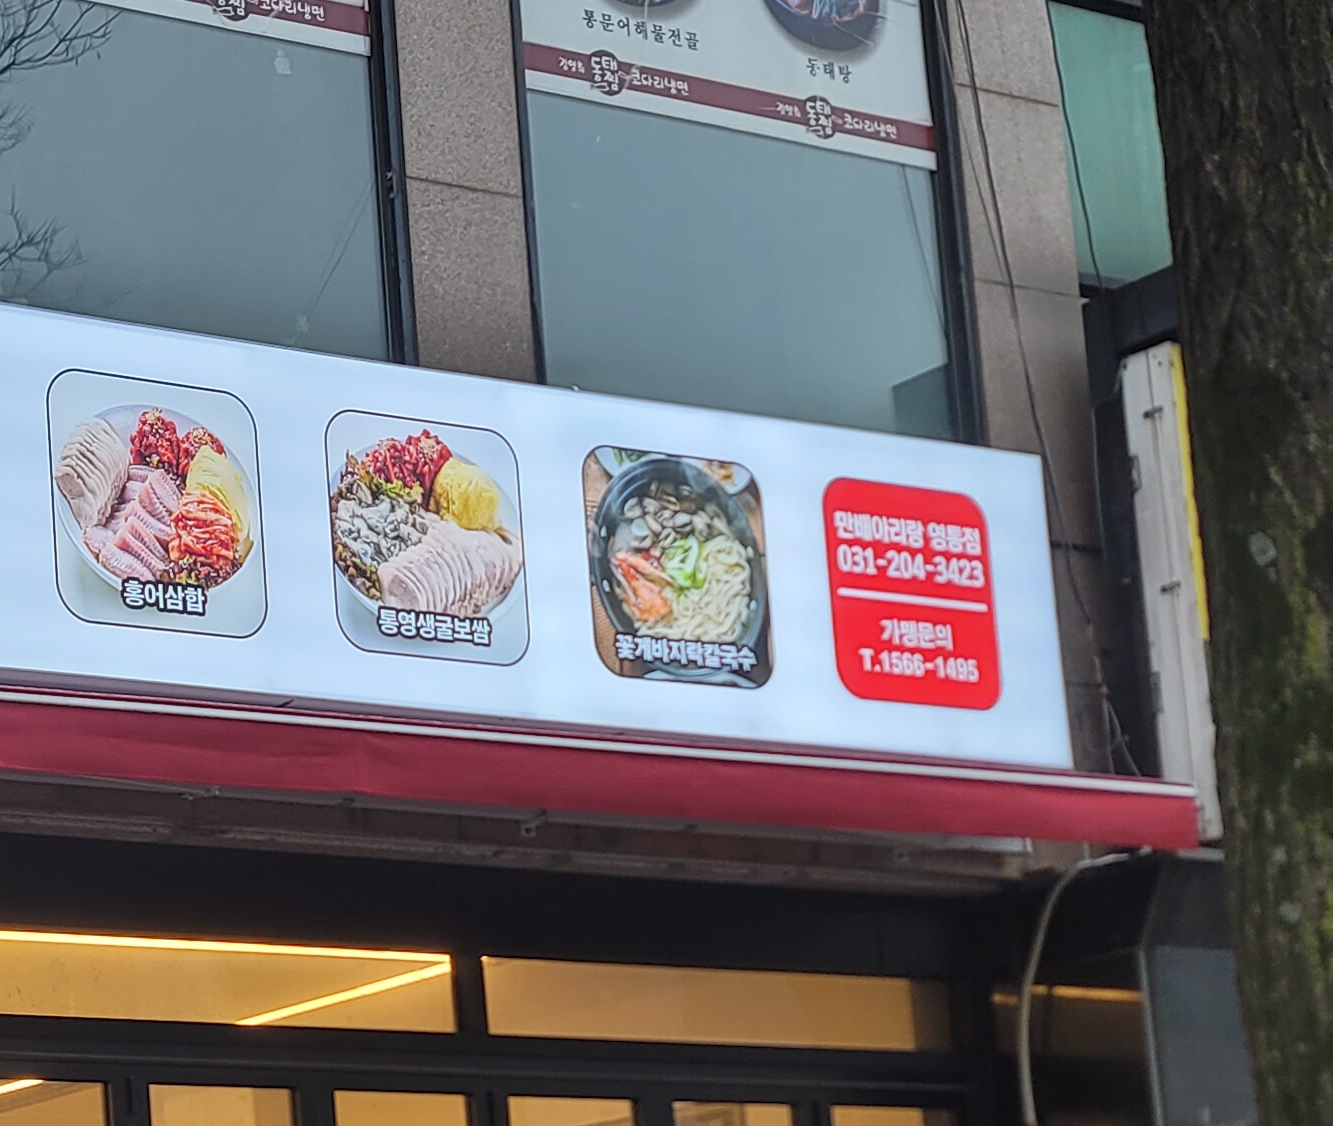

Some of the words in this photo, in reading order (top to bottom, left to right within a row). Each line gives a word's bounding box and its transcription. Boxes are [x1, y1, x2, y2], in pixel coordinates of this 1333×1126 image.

[631, 67, 690, 96] 코다리냉면
[834, 511, 924, 548] 만배아리랑
[927, 522, 982, 555] 영통점
[837, 545, 985, 588] 031-204-3423
[121, 579, 207, 615] 홍어삼합
[378, 608, 492, 645] 통영생굴보쌈
[880, 619, 954, 651] 가맹문의
[614, 633, 759, 673] 꽃게바지락칼국수
[859, 648, 980, 683] T.1566-1495
